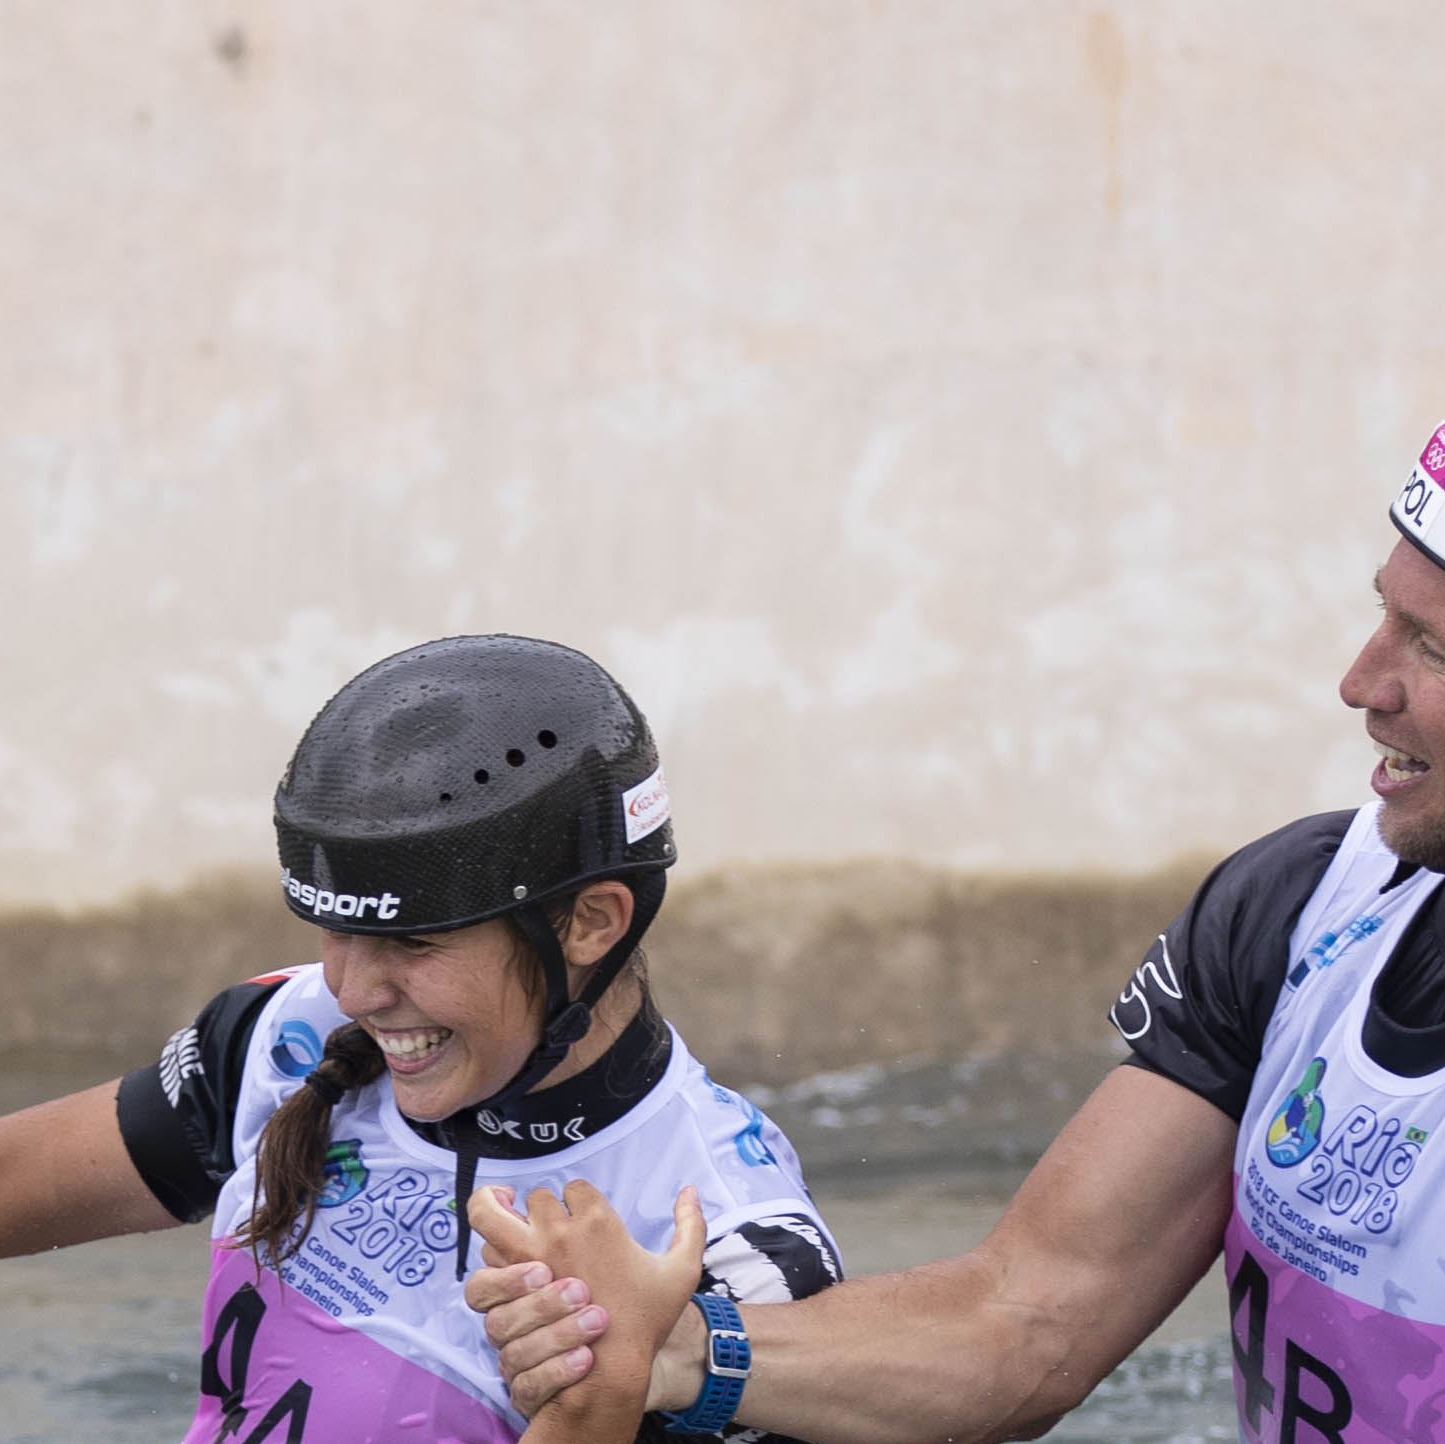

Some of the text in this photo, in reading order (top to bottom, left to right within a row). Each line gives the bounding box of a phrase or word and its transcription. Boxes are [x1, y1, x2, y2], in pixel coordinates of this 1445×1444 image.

[1297, 1154, 1398, 1234] 2018
[330, 1199, 435, 1288] 2018
[1266, 1211, 1359, 1277] Championships
[1266, 1236, 1281, 1255] de
[1281, 1248, 1327, 1282] Janeiro
[1279, 1201, 1316, 1235] Canoe
[1317, 1225, 1367, 1259] Slalom
[287, 1250, 375, 1317] hampionships
[296, 1278, 342, 1317] Janeiro
[306, 1236, 389, 1305] Canoe Slalom
